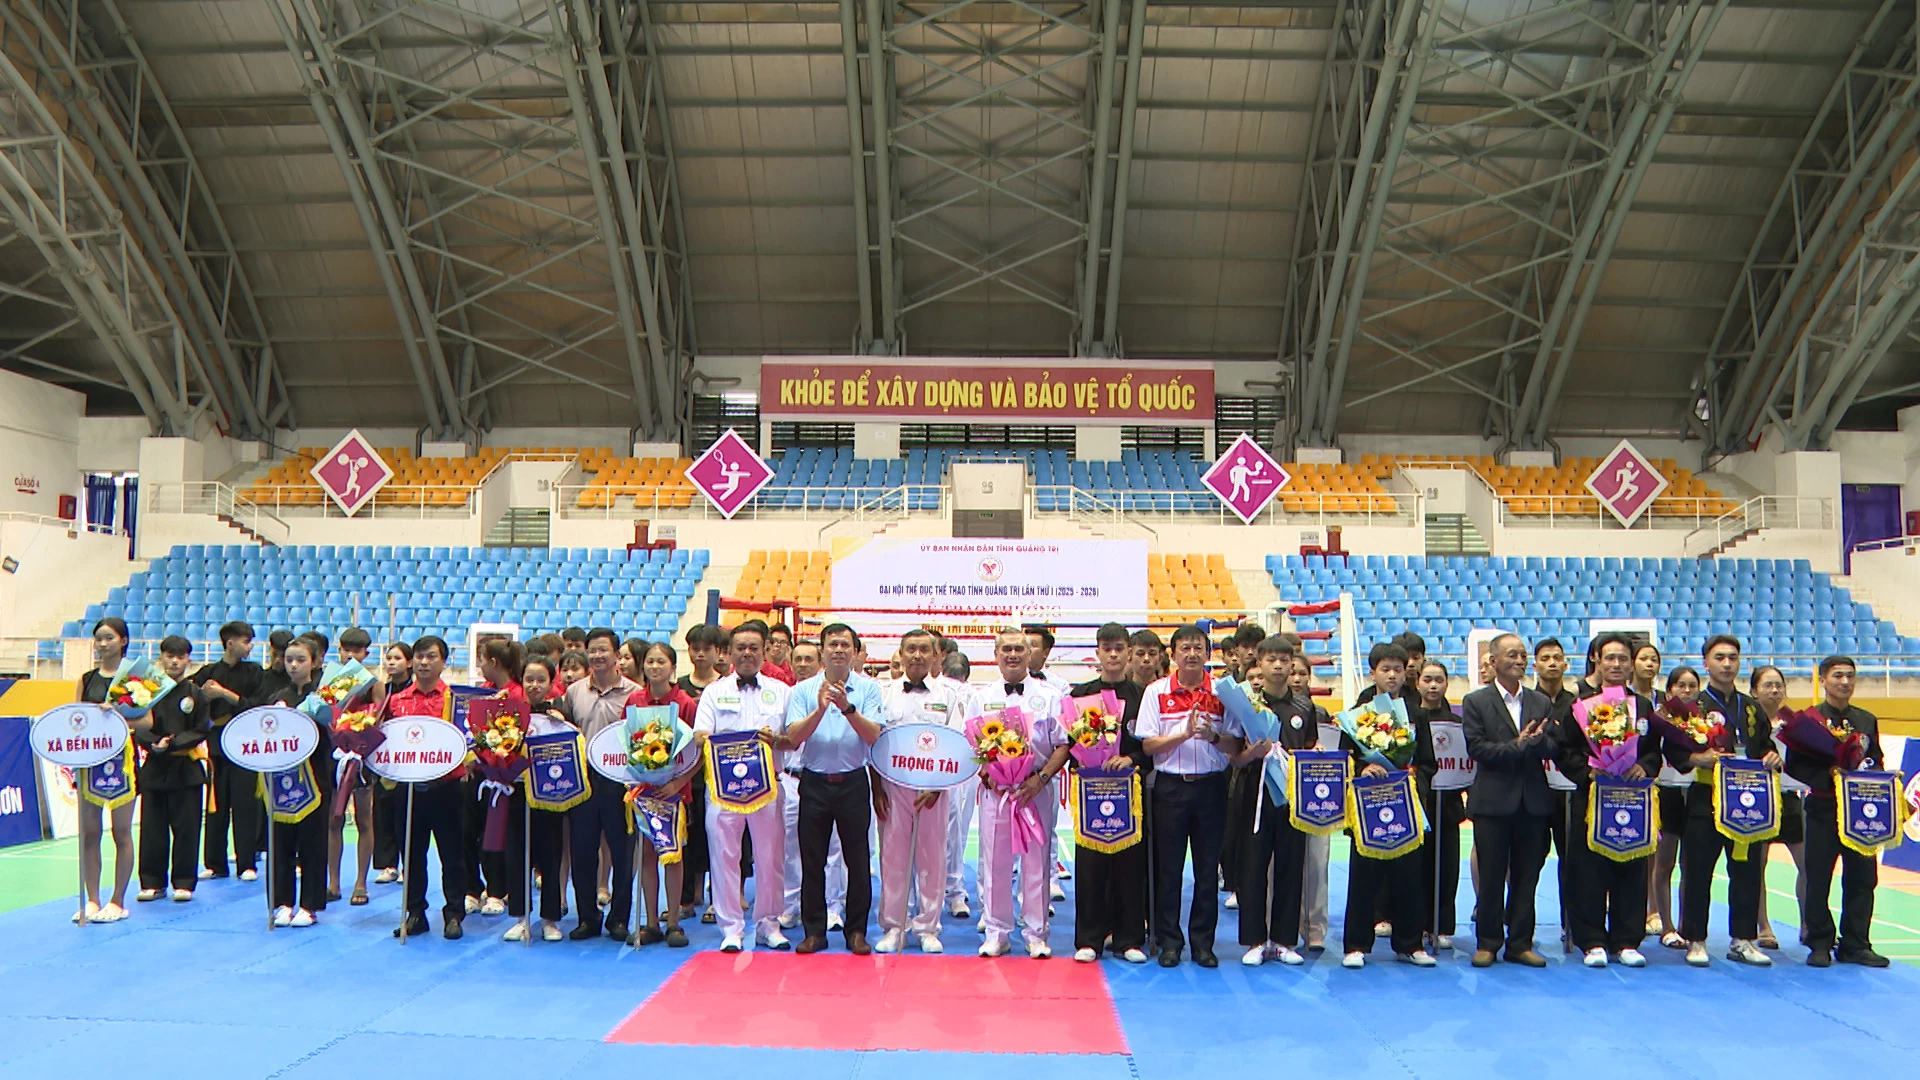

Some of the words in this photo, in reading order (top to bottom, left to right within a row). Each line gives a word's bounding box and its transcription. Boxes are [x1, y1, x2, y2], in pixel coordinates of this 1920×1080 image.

[780, 368, 836, 406] KHỎE
[841, 369, 872, 406] ĐỂ
[876, 374, 918, 406] XÂY
[924, 379, 984, 413] DỰNG
[990, 376, 1018, 408] VÀ
[1024, 371, 1067, 409] BẢO
[1073, 377, 1100, 414] VỆ
[1106, 373, 1133, 410] TỔ
[1138, 375, 1196, 412] QUỐC
[951, 544, 975, 552] NHÂN
[976, 544, 994, 552] DÂN
[1016, 544, 1046, 553] QUẢNG
[1048, 545, 1059, 554] TRỊ
[879, 585, 891, 597] ĐẠI
[920, 585, 933, 597] DỤC
[949, 585, 966, 596] THAO
[985, 582, 1008, 596] QUẢNG
[1009, 585, 1020, 597] TRỊ
[1056, 586, 1074, 597] (2025
[66, 734, 89, 752] BẾN
[281, 735, 299, 752] TỬ
[394, 751, 416, 764] KIM
[420, 748, 452, 764] NGÂN
[891, 755, 935, 772] TRỌNG
[939, 758, 959, 774] TÀI
[1437, 757, 1455, 770] AM
[0, 785, 23, 816] ƠN
